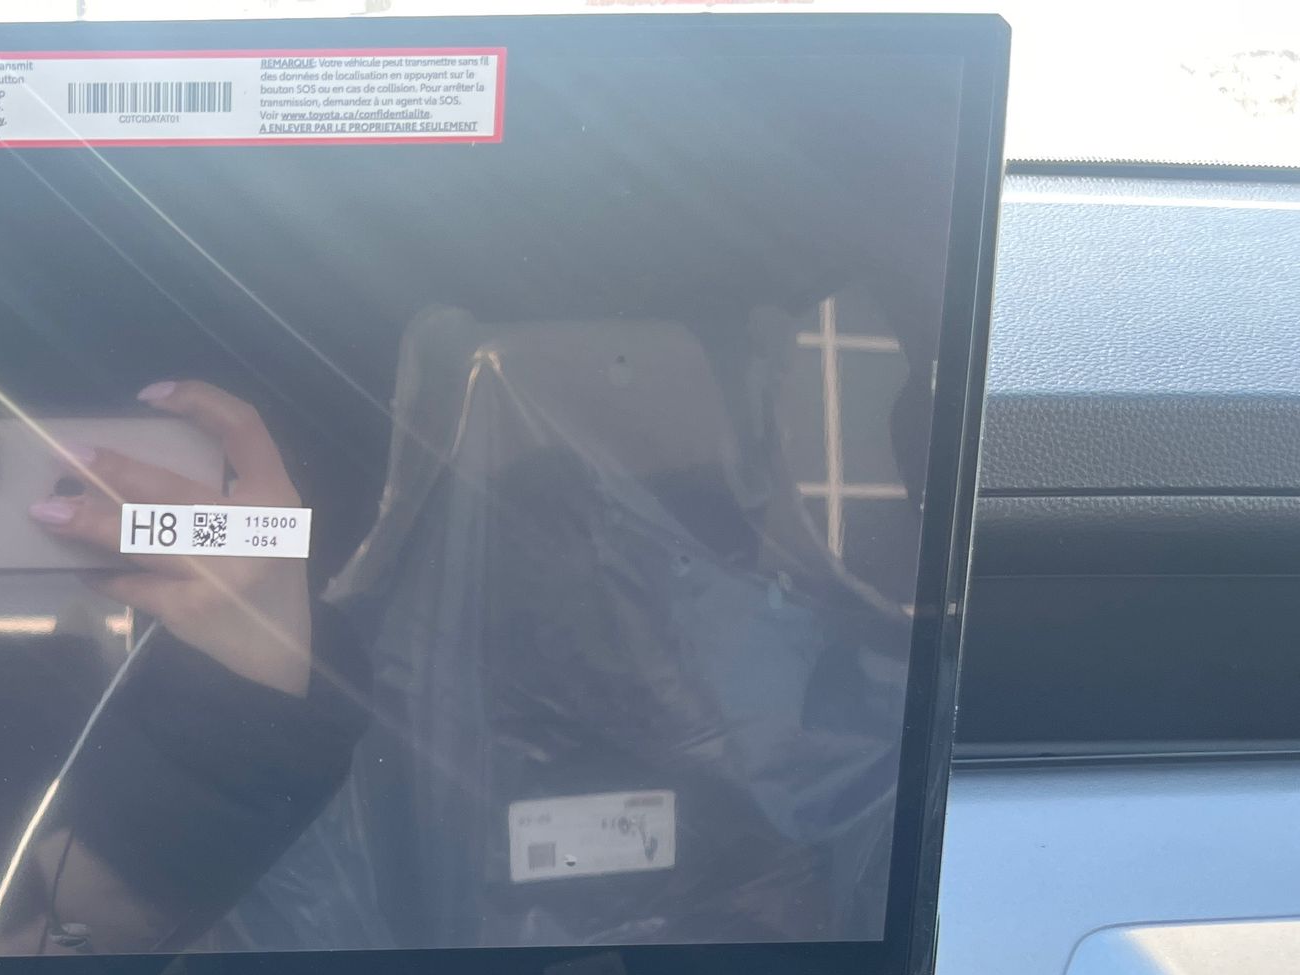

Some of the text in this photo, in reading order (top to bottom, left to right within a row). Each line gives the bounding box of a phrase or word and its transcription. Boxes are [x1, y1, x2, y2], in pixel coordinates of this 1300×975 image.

[319, 58, 343, 68] Votre
[344, 57, 381, 68] véhicule
[382, 58, 403, 69] peut
[405, 58, 456, 67] transmettre
[459, 58, 478, 67] sans
[480, 56, 489, 66] fil
[260, 69, 475, 81] des données de localisation en appuyant sur le
[260, 85, 294, 94] bouton
[296, 84, 316, 94] SOS
[318, 86, 330, 94] ou
[332, 86, 344, 94] en
[363, 84, 376, 93] de
[377, 83, 418, 93] collision.
[420, 83, 441, 92] Pour
[443, 83, 475, 92] arrêter
[476, 82, 485, 92] la
[260, 96, 462, 108] transmission, demandez à un agent via SOS.
[260, 111, 279, 120] Voir
[269, 123, 312, 133] ENLEVER
[314, 123, 333, 133] PAR
[336, 123, 347, 133] LE
[348, 122, 418, 133] PROPRIETAIRE
[420, 121, 478, 132] SEULEMENT
[131, 510, 178, 547] H8
[245, 516, 297, 529] 115000
[245, 536, 277, 547] -054
